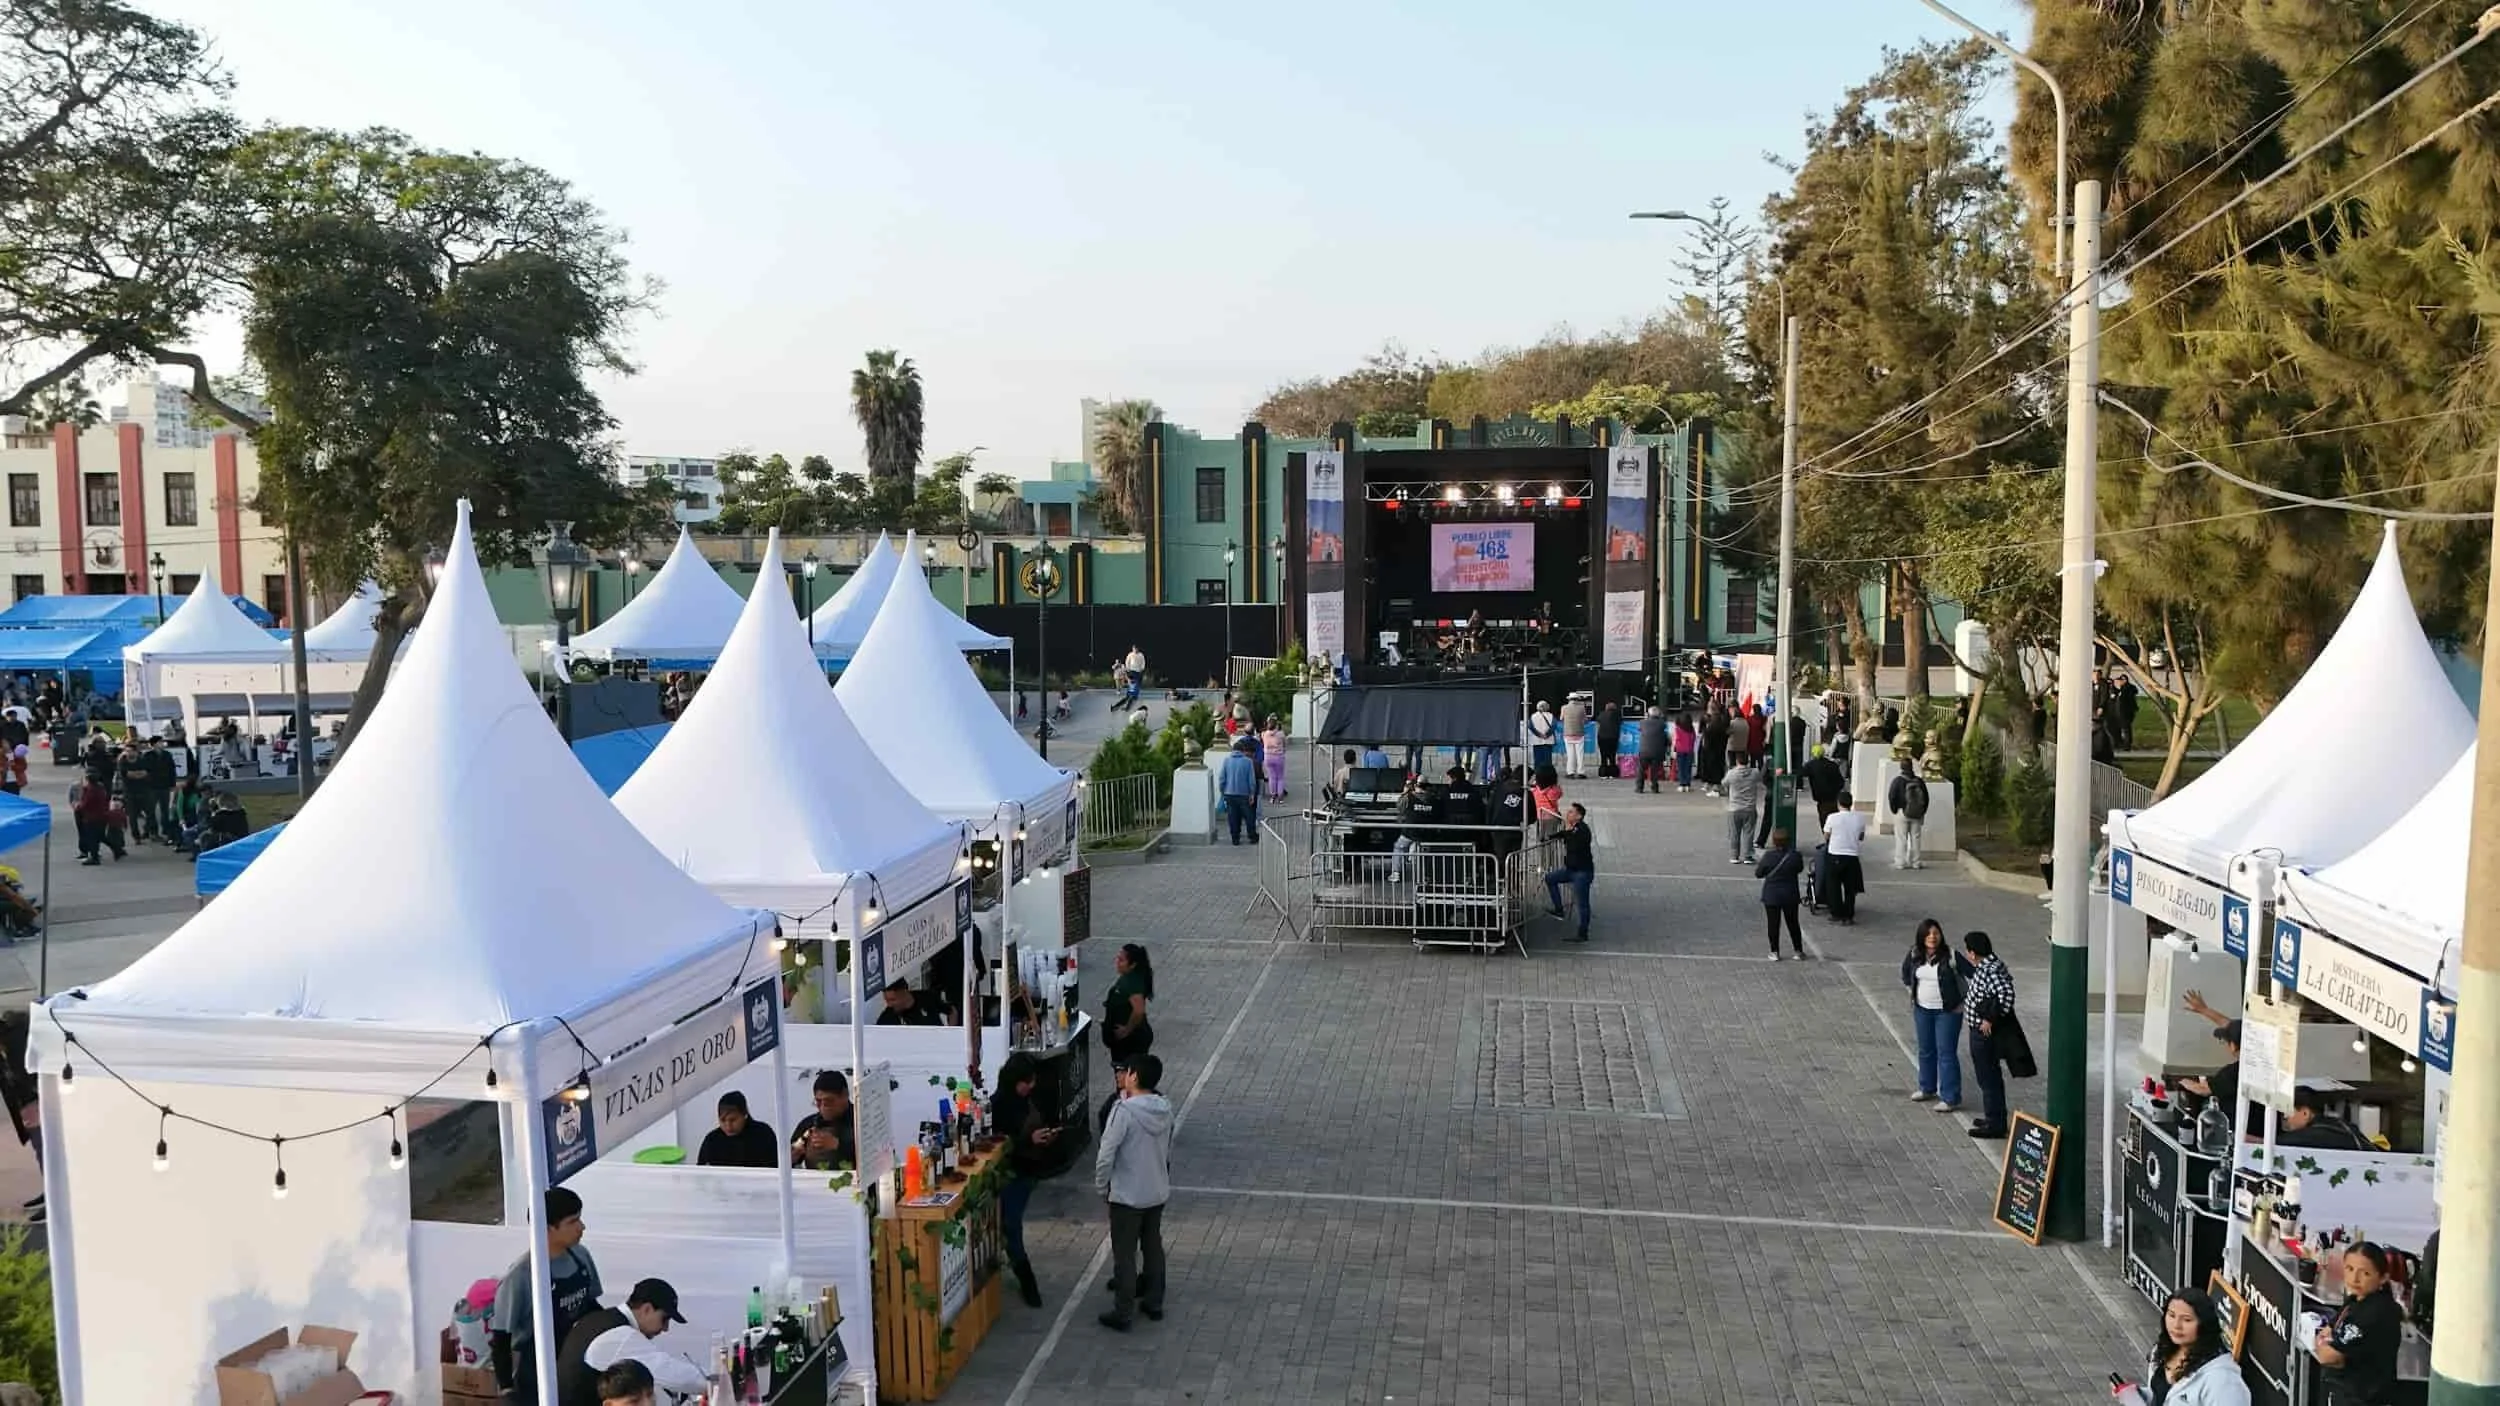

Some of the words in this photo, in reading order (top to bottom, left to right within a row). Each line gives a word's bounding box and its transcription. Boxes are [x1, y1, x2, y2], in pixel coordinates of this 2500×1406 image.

[2135, 871, 2166, 897] PISCO
[2168, 884, 2217, 921] LEGADO
[2305, 965, 2324, 992] LA
[2327, 974, 2408, 1035] CARAVEDO
[605, 1066, 664, 1125] VIÑAS
[671, 1048, 696, 1085] DE
[702, 1025, 736, 1065] ORO
[2135, 1183, 2170, 1225] LEGADO
